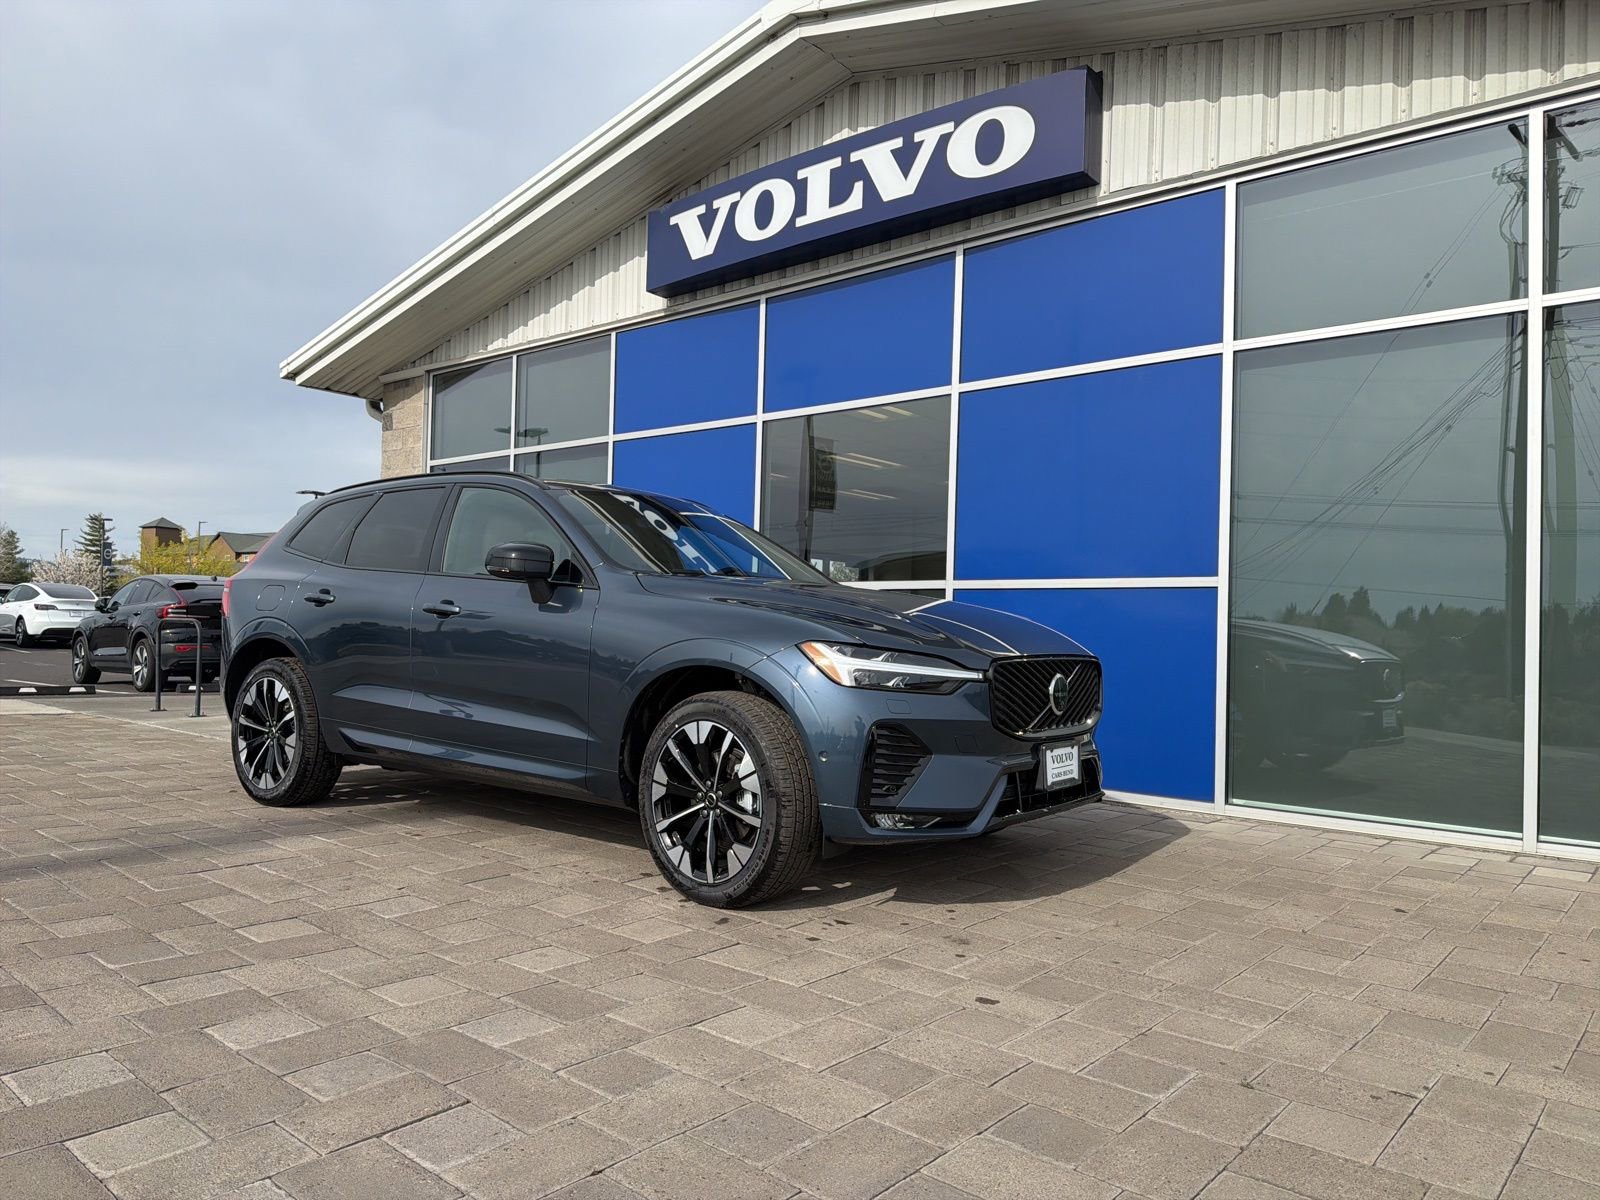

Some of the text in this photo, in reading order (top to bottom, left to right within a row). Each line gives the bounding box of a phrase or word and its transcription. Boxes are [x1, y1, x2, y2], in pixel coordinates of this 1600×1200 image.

[669, 105, 1036, 261] VOLVO
[1051, 751, 1074, 765] VOLVO
[1051, 770, 1063, 779] CARS
